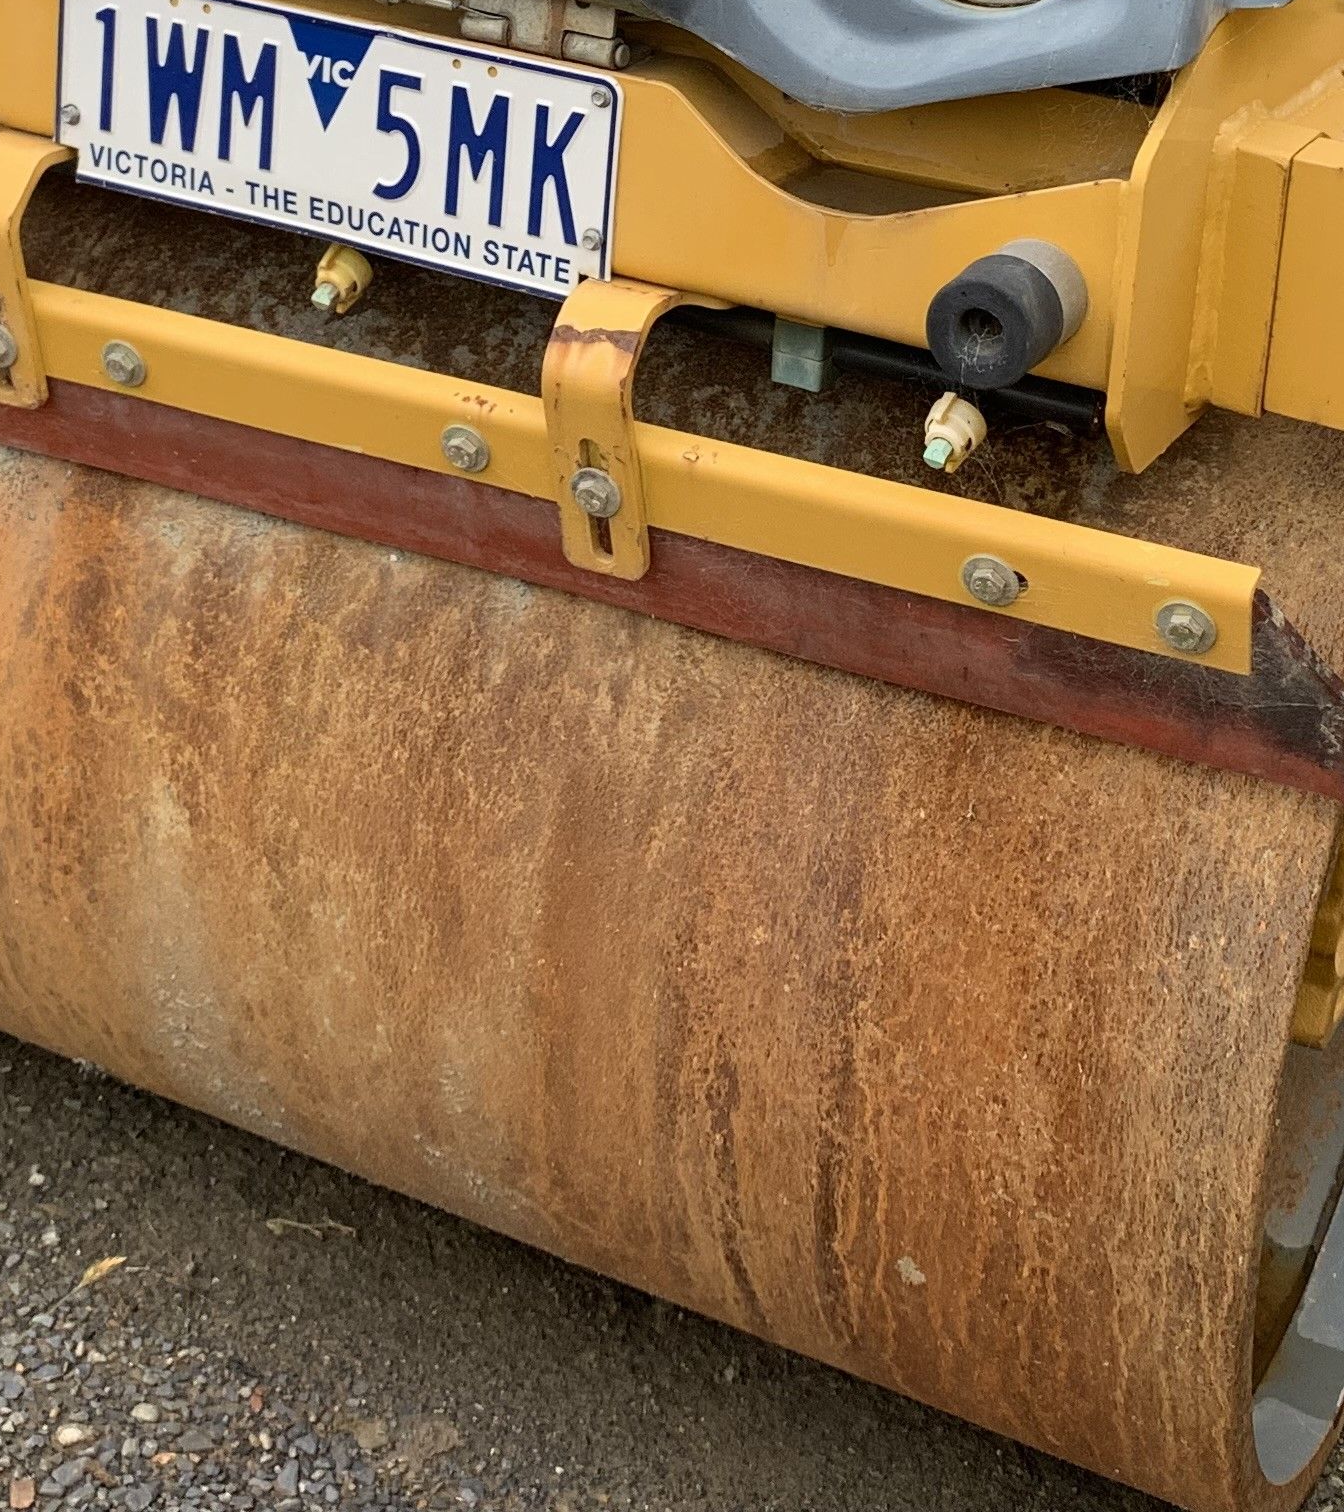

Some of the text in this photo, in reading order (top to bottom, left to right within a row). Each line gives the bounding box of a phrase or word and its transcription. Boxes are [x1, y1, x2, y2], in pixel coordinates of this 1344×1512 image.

[95, 6, 586, 247] 1WM 5MK
[305, 53, 357, 89] VIC
[89, 142, 216, 196] VICTORIA
[245, 180, 299, 216] THE
[309, 195, 472, 260] EDUCATION
[482, 239, 571, 285] STATE
